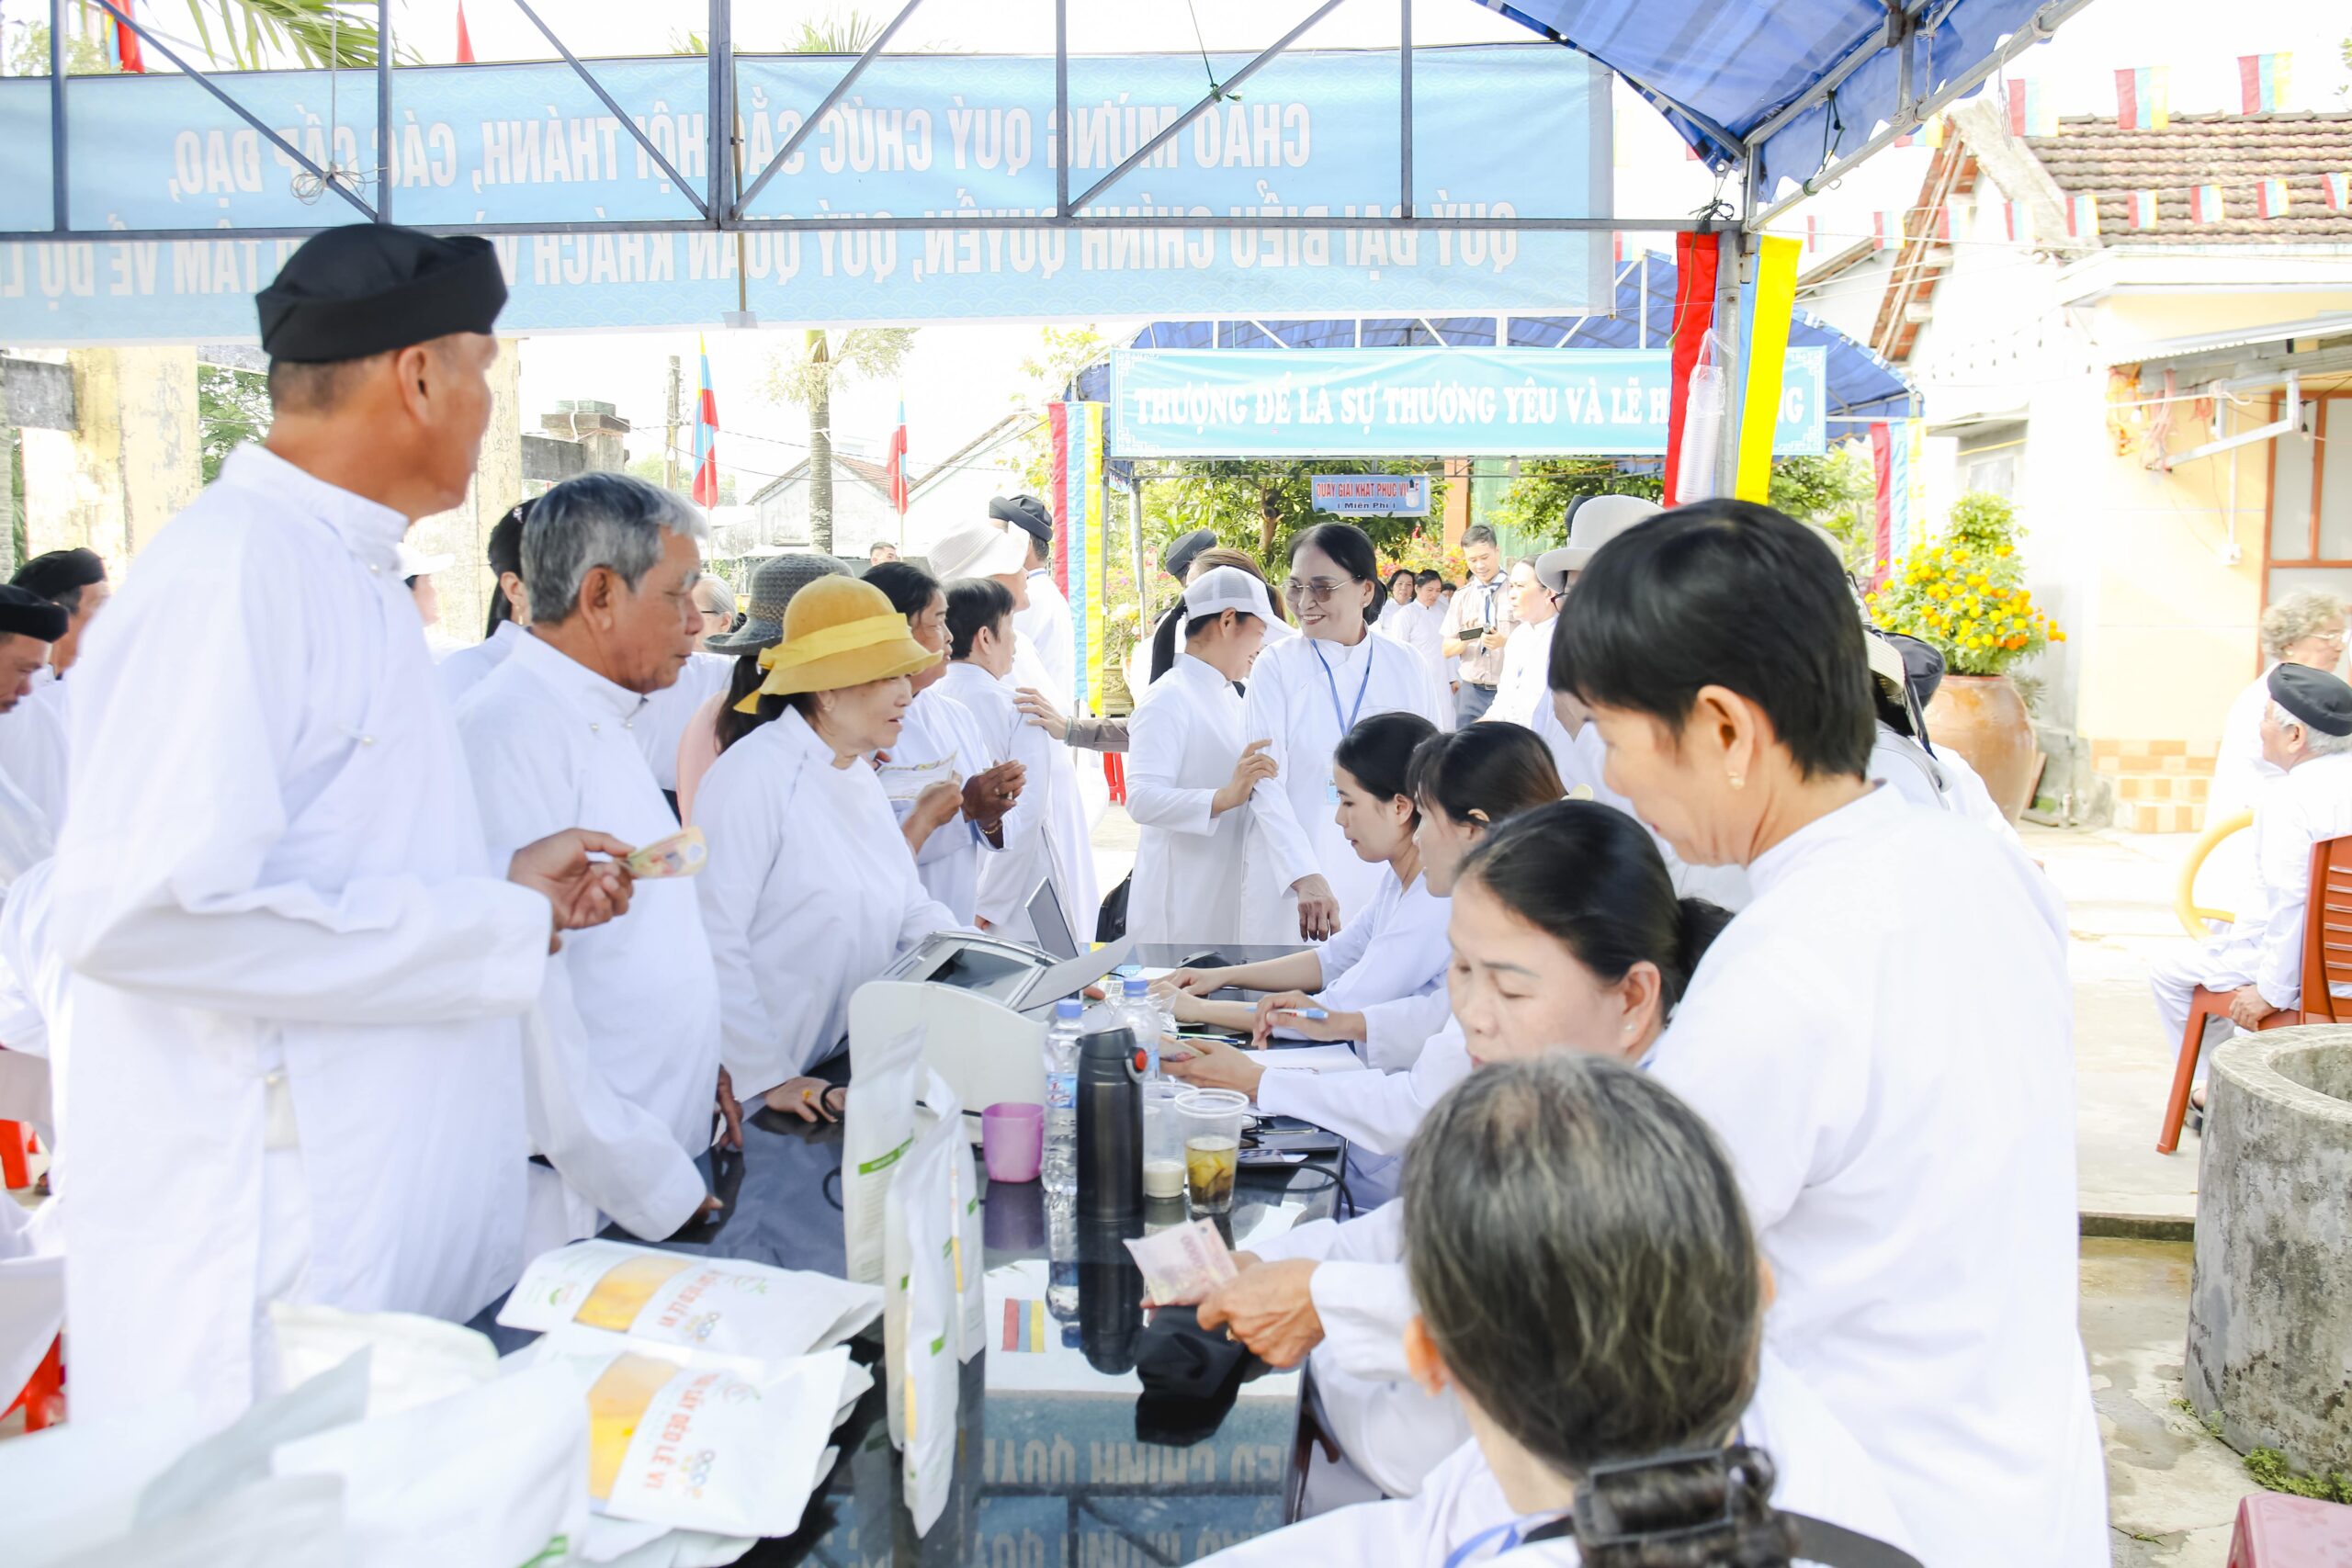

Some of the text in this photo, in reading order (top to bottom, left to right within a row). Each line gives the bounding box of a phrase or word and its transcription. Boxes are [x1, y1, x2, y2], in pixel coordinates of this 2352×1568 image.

[1133, 380, 1249, 435] THƯỢNG
[1254, 370, 1292, 424] ĐẾ
[1340, 379, 1378, 435] SỰ
[1382, 379, 1497, 424] THƯƠNG
[1503, 375, 1559, 424] YÊU
[1564, 376, 1604, 424] VÀ
[1610, 376, 1644, 424] LẼ
